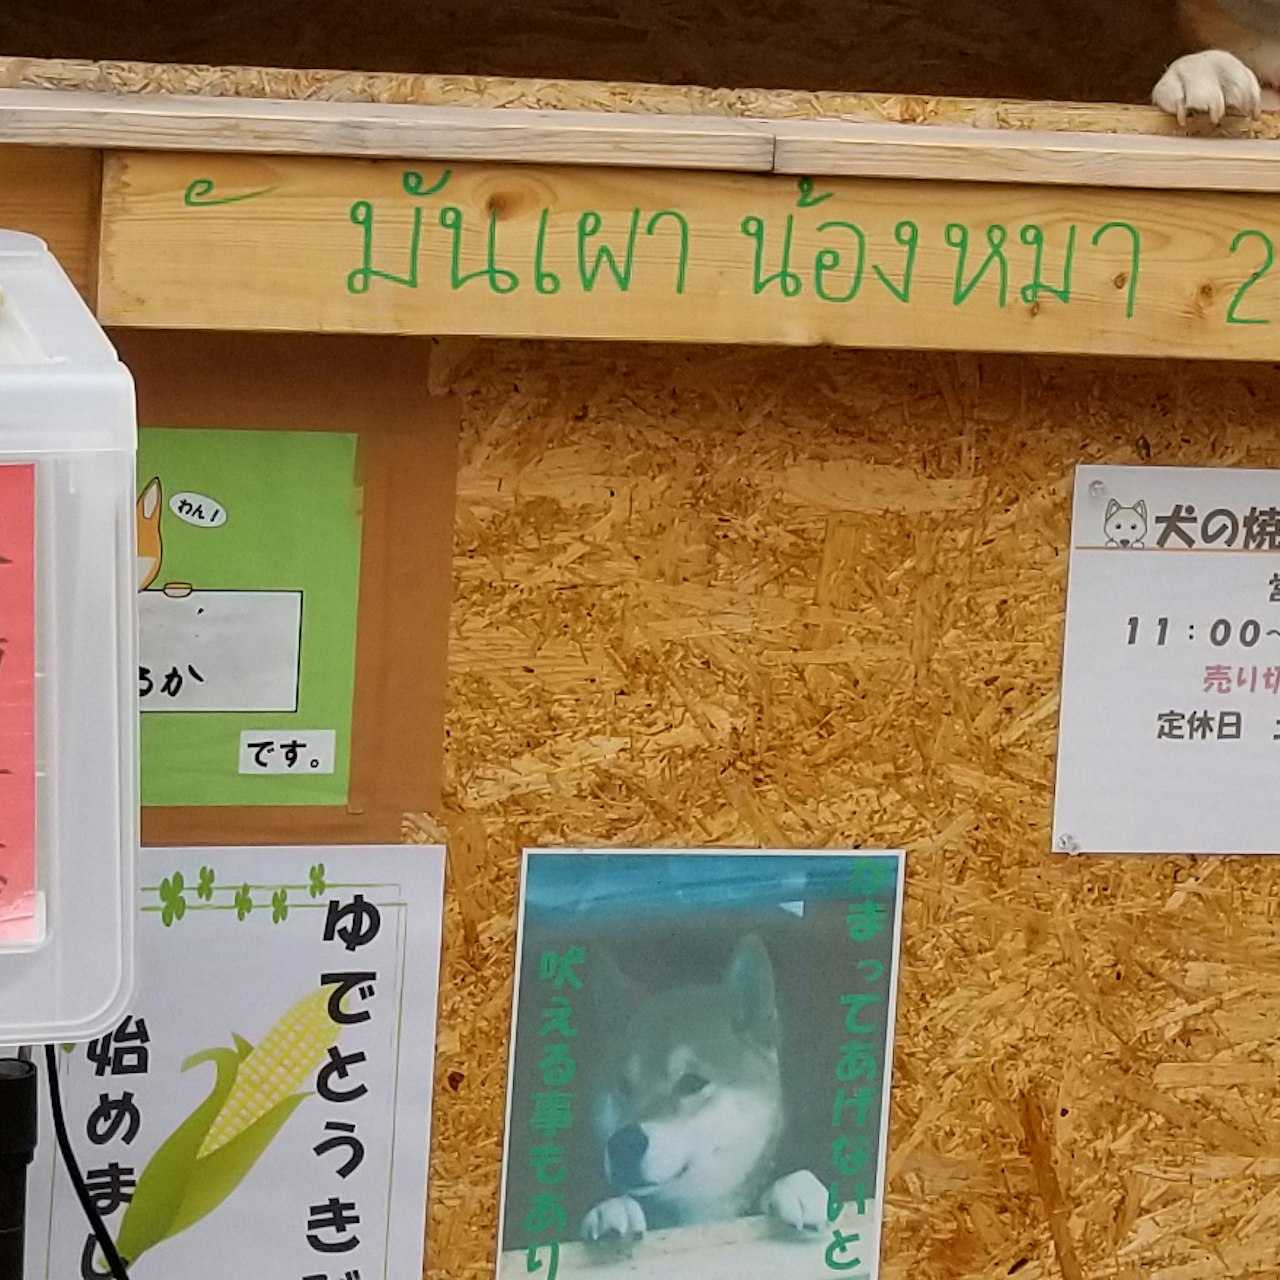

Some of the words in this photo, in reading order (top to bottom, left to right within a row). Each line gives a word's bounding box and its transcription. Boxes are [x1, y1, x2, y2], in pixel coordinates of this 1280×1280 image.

[1156, 710, 1242, 741] 定休日
[246, 739, 320, 769] です。
[302, 894, 381, 1280] ゆでとうき
